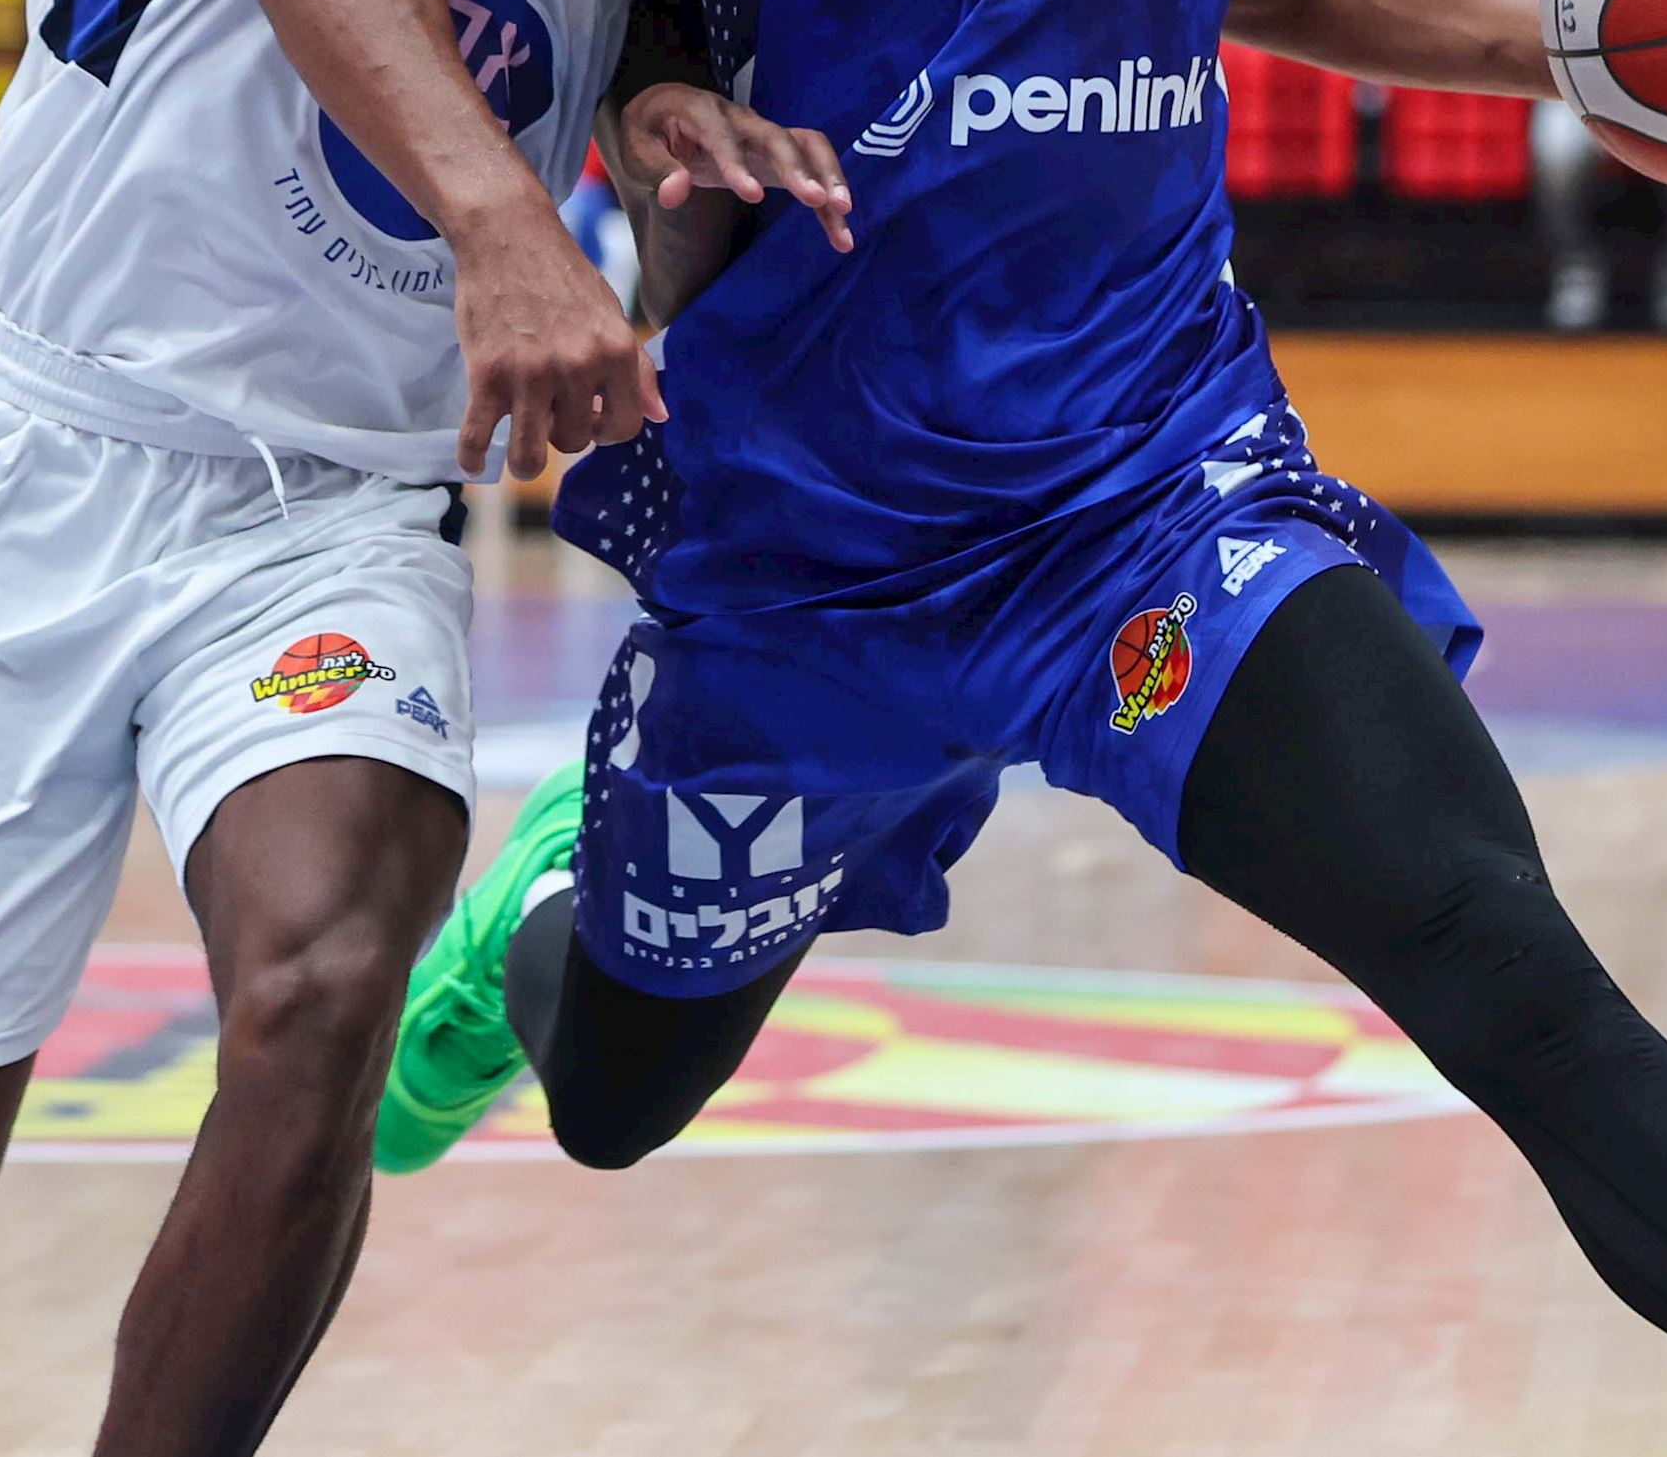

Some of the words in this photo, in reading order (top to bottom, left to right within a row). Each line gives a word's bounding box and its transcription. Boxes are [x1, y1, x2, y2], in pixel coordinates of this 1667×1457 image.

[950, 55, 1213, 147] penlink
[274, 167, 327, 235] עתיד
[1220, 537, 1288, 597] PEAK
[252, 664, 365, 701] Winner
[321, 650, 364, 670] ליגת
[365, 661, 395, 679] סל
[1113, 624, 1173, 730] Winner
[395, 698, 451, 740] PEAK
[623, 867, 844, 949] יובלים
